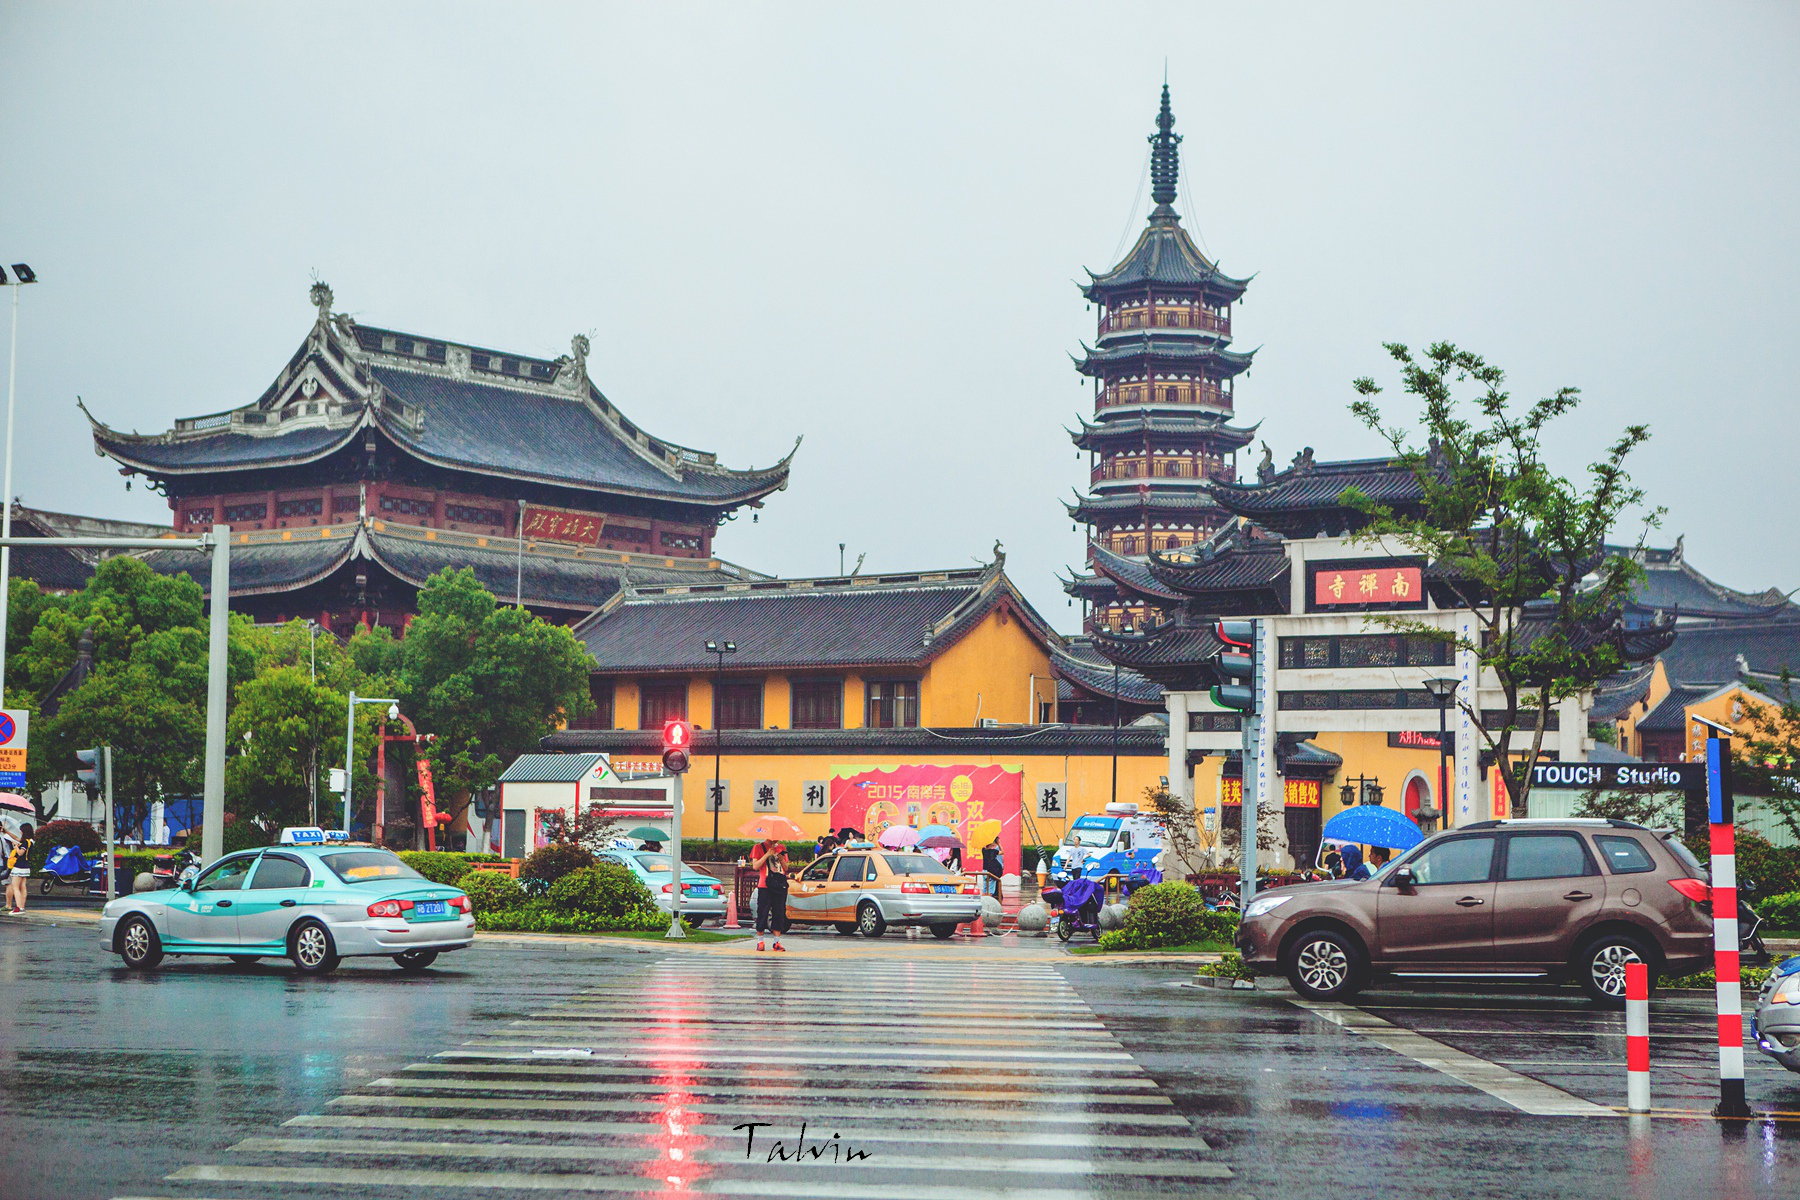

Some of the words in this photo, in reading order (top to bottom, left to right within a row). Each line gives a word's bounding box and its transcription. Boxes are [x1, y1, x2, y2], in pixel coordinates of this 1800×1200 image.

[1534, 766, 1602, 784] TOUCH
[1616, 766, 1681, 785] Studio
[806, 784, 825, 808] 利
[868, 785, 904, 799] 2015
[907, 785, 946, 799] 南禅寺
[1284, 781, 1318, 805] 销售处
